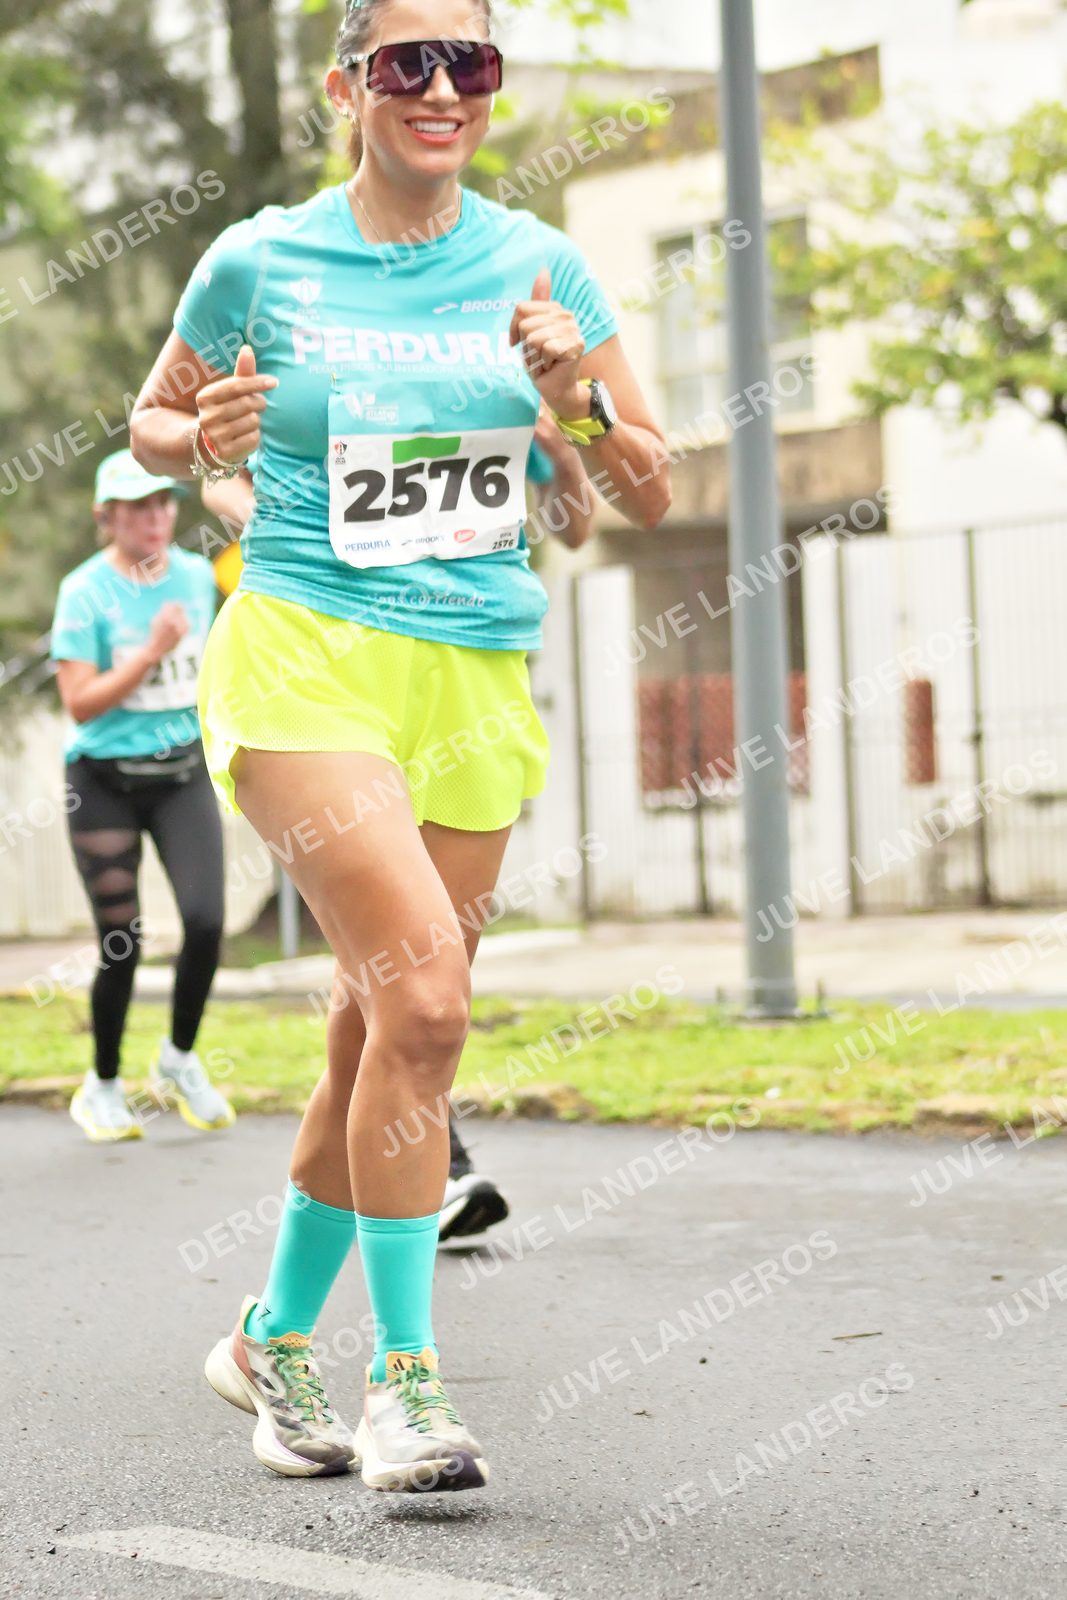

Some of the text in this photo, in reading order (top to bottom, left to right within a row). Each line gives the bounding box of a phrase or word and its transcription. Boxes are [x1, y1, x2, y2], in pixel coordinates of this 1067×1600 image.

[291, 327, 525, 368] PERDURA
[343, 456, 511, 523] 2576
[345, 539, 391, 552] PERDURA
[492, 539, 514, 550] 2576
